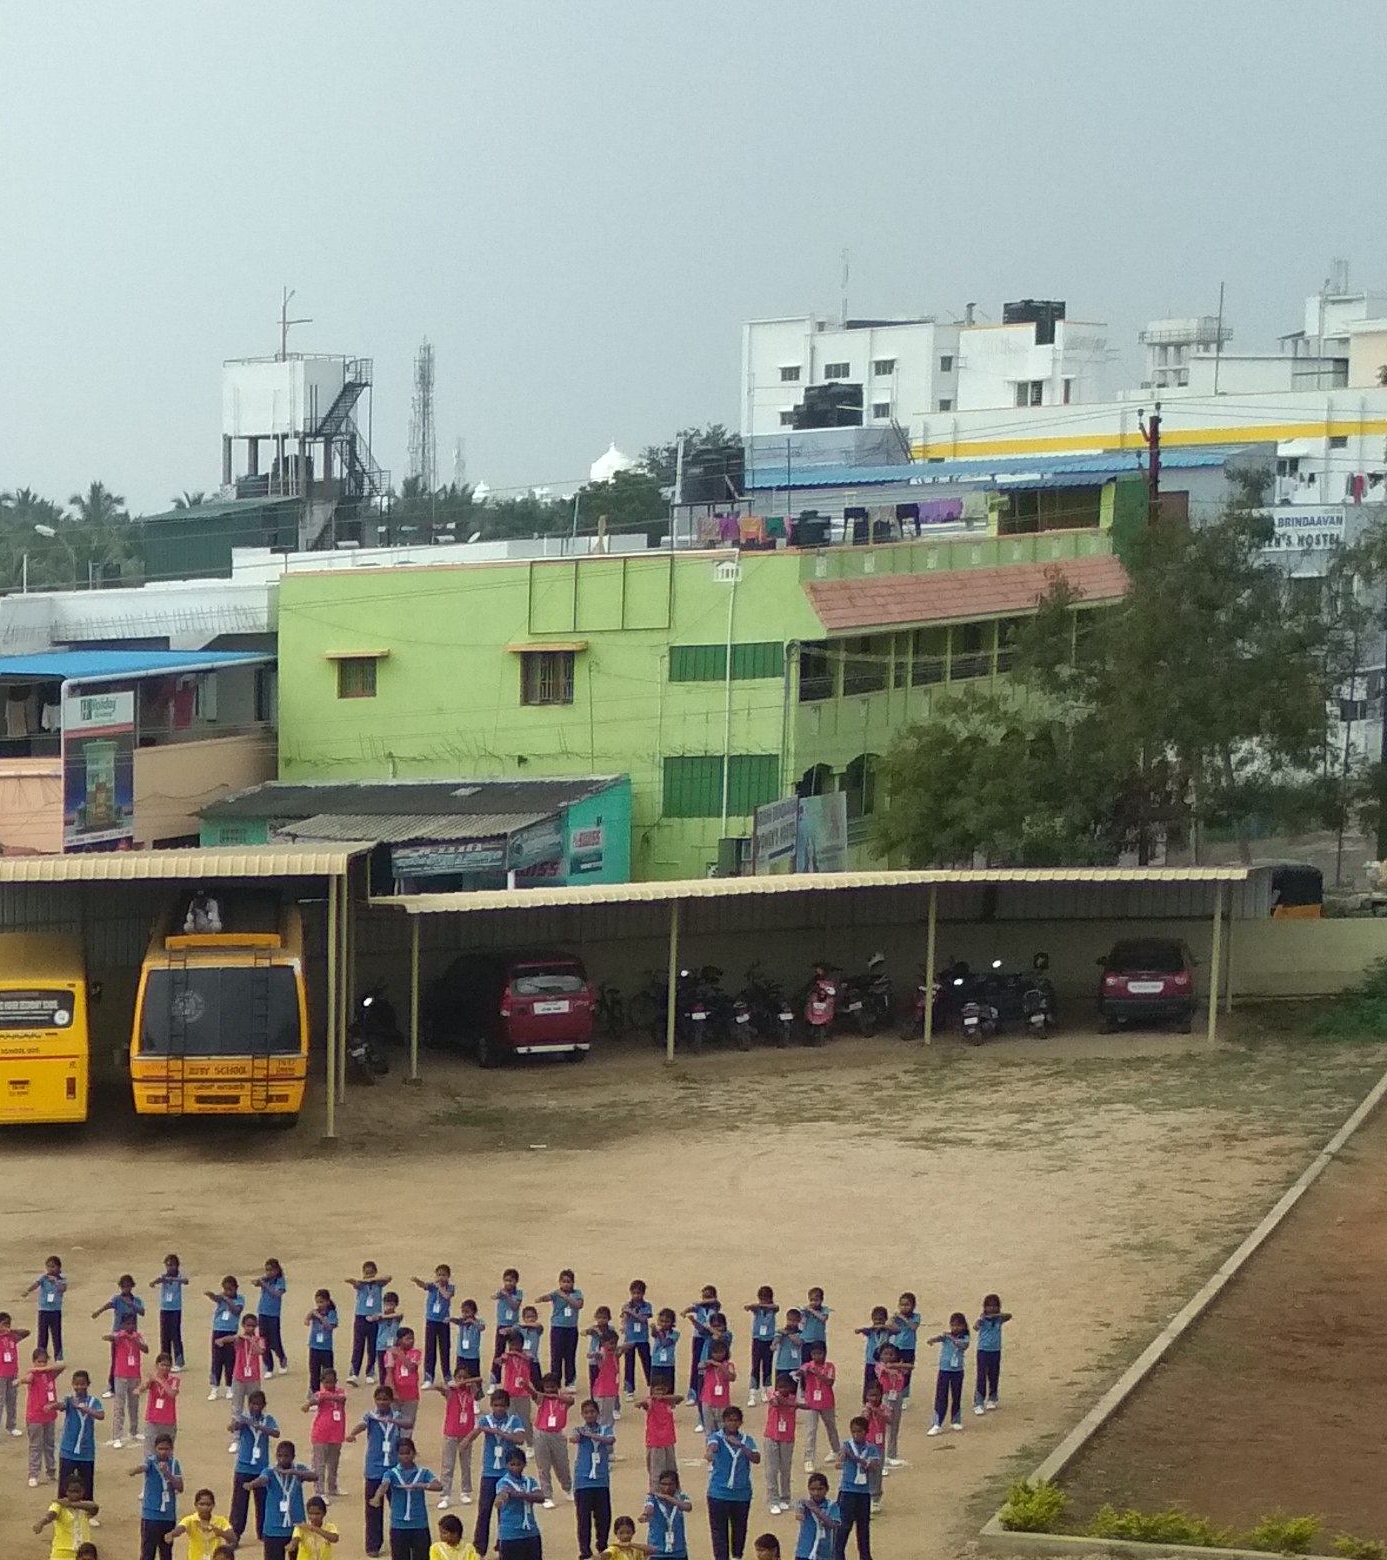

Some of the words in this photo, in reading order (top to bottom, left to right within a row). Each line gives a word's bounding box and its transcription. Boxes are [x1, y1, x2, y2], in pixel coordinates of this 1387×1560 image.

[1278, 516, 1343, 527] BRINDAAVAN
[1297, 533, 1340, 548] HOSTEL
[214, 1066, 247, 1075] SCHOOL
